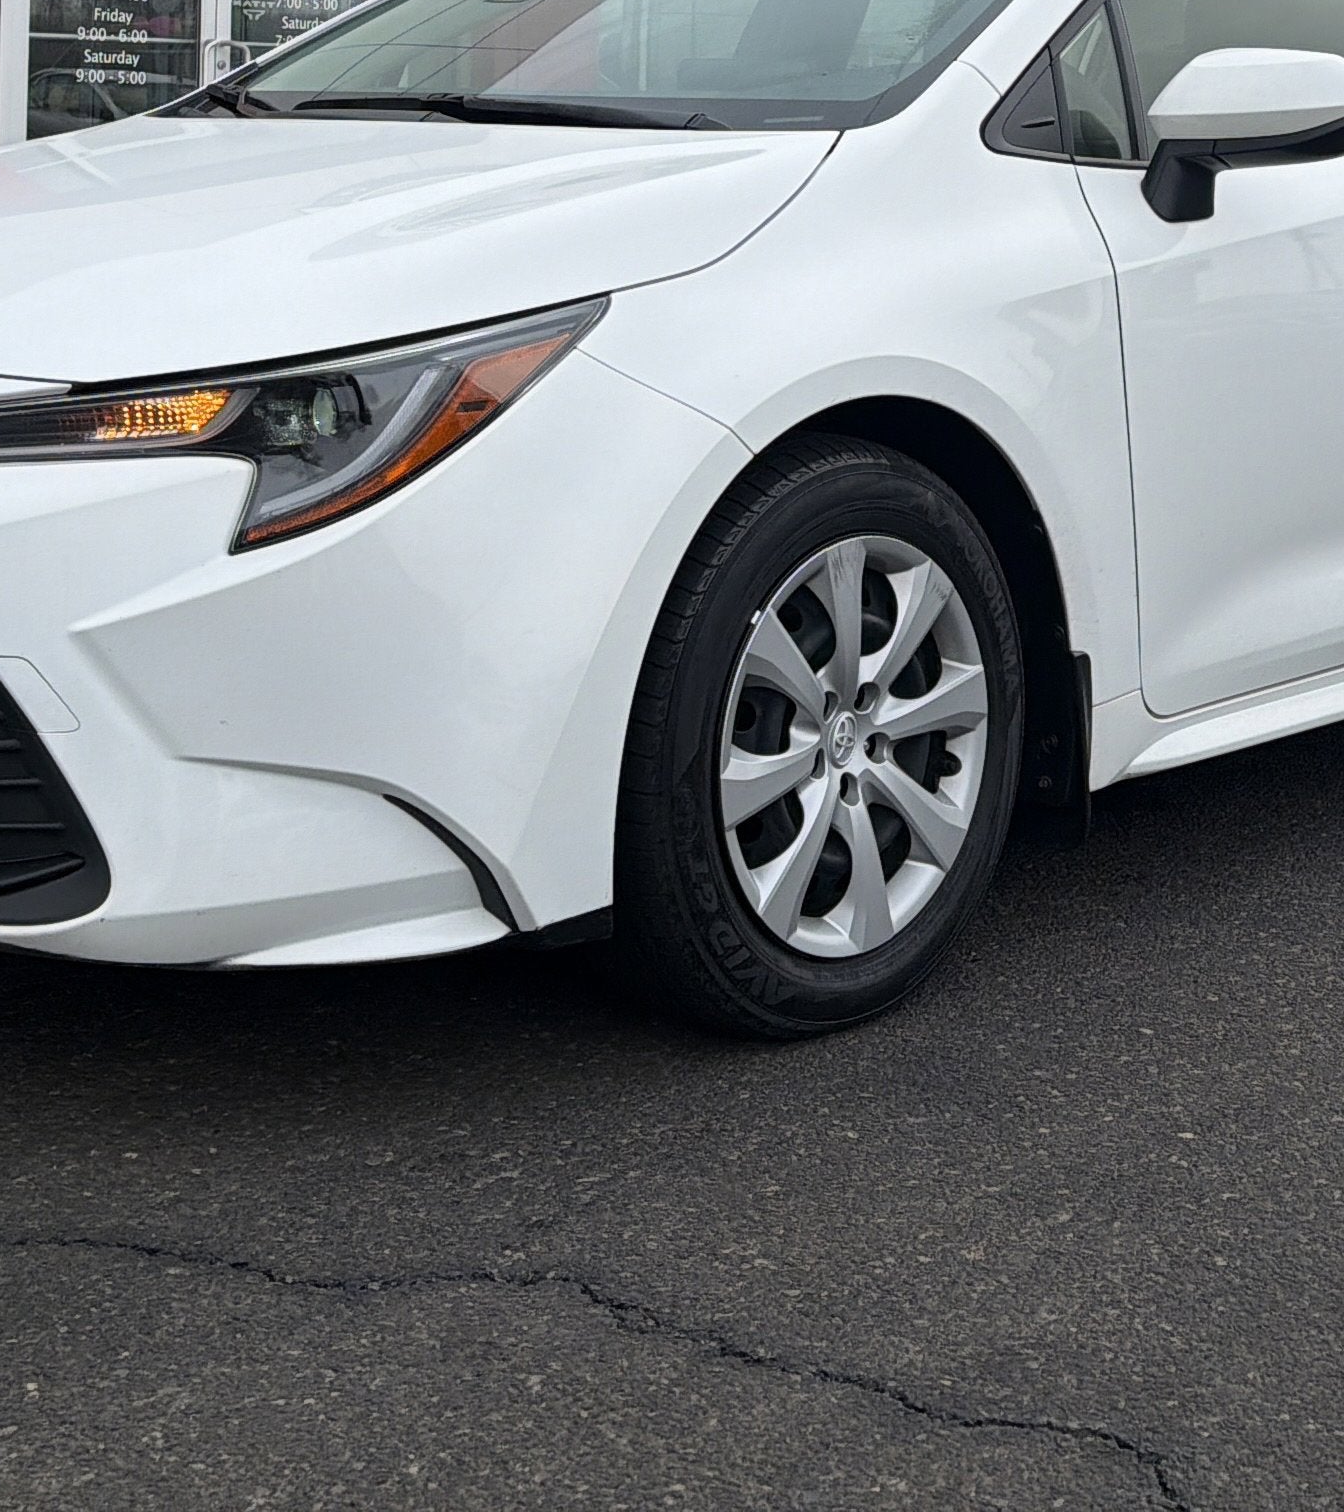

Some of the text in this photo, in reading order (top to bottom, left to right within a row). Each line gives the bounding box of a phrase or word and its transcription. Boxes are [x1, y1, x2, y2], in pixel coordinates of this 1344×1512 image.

[93, 7, 134, 26] Friday
[281, 15, 325, 30] Saturd
[77, 26, 107, 42] 9:00
[118, 28, 149, 44] 6:00
[83, 49, 141, 68] Saturday
[75, 68, 106, 84] 9:00
[117, 70, 148, 85] 5:00
